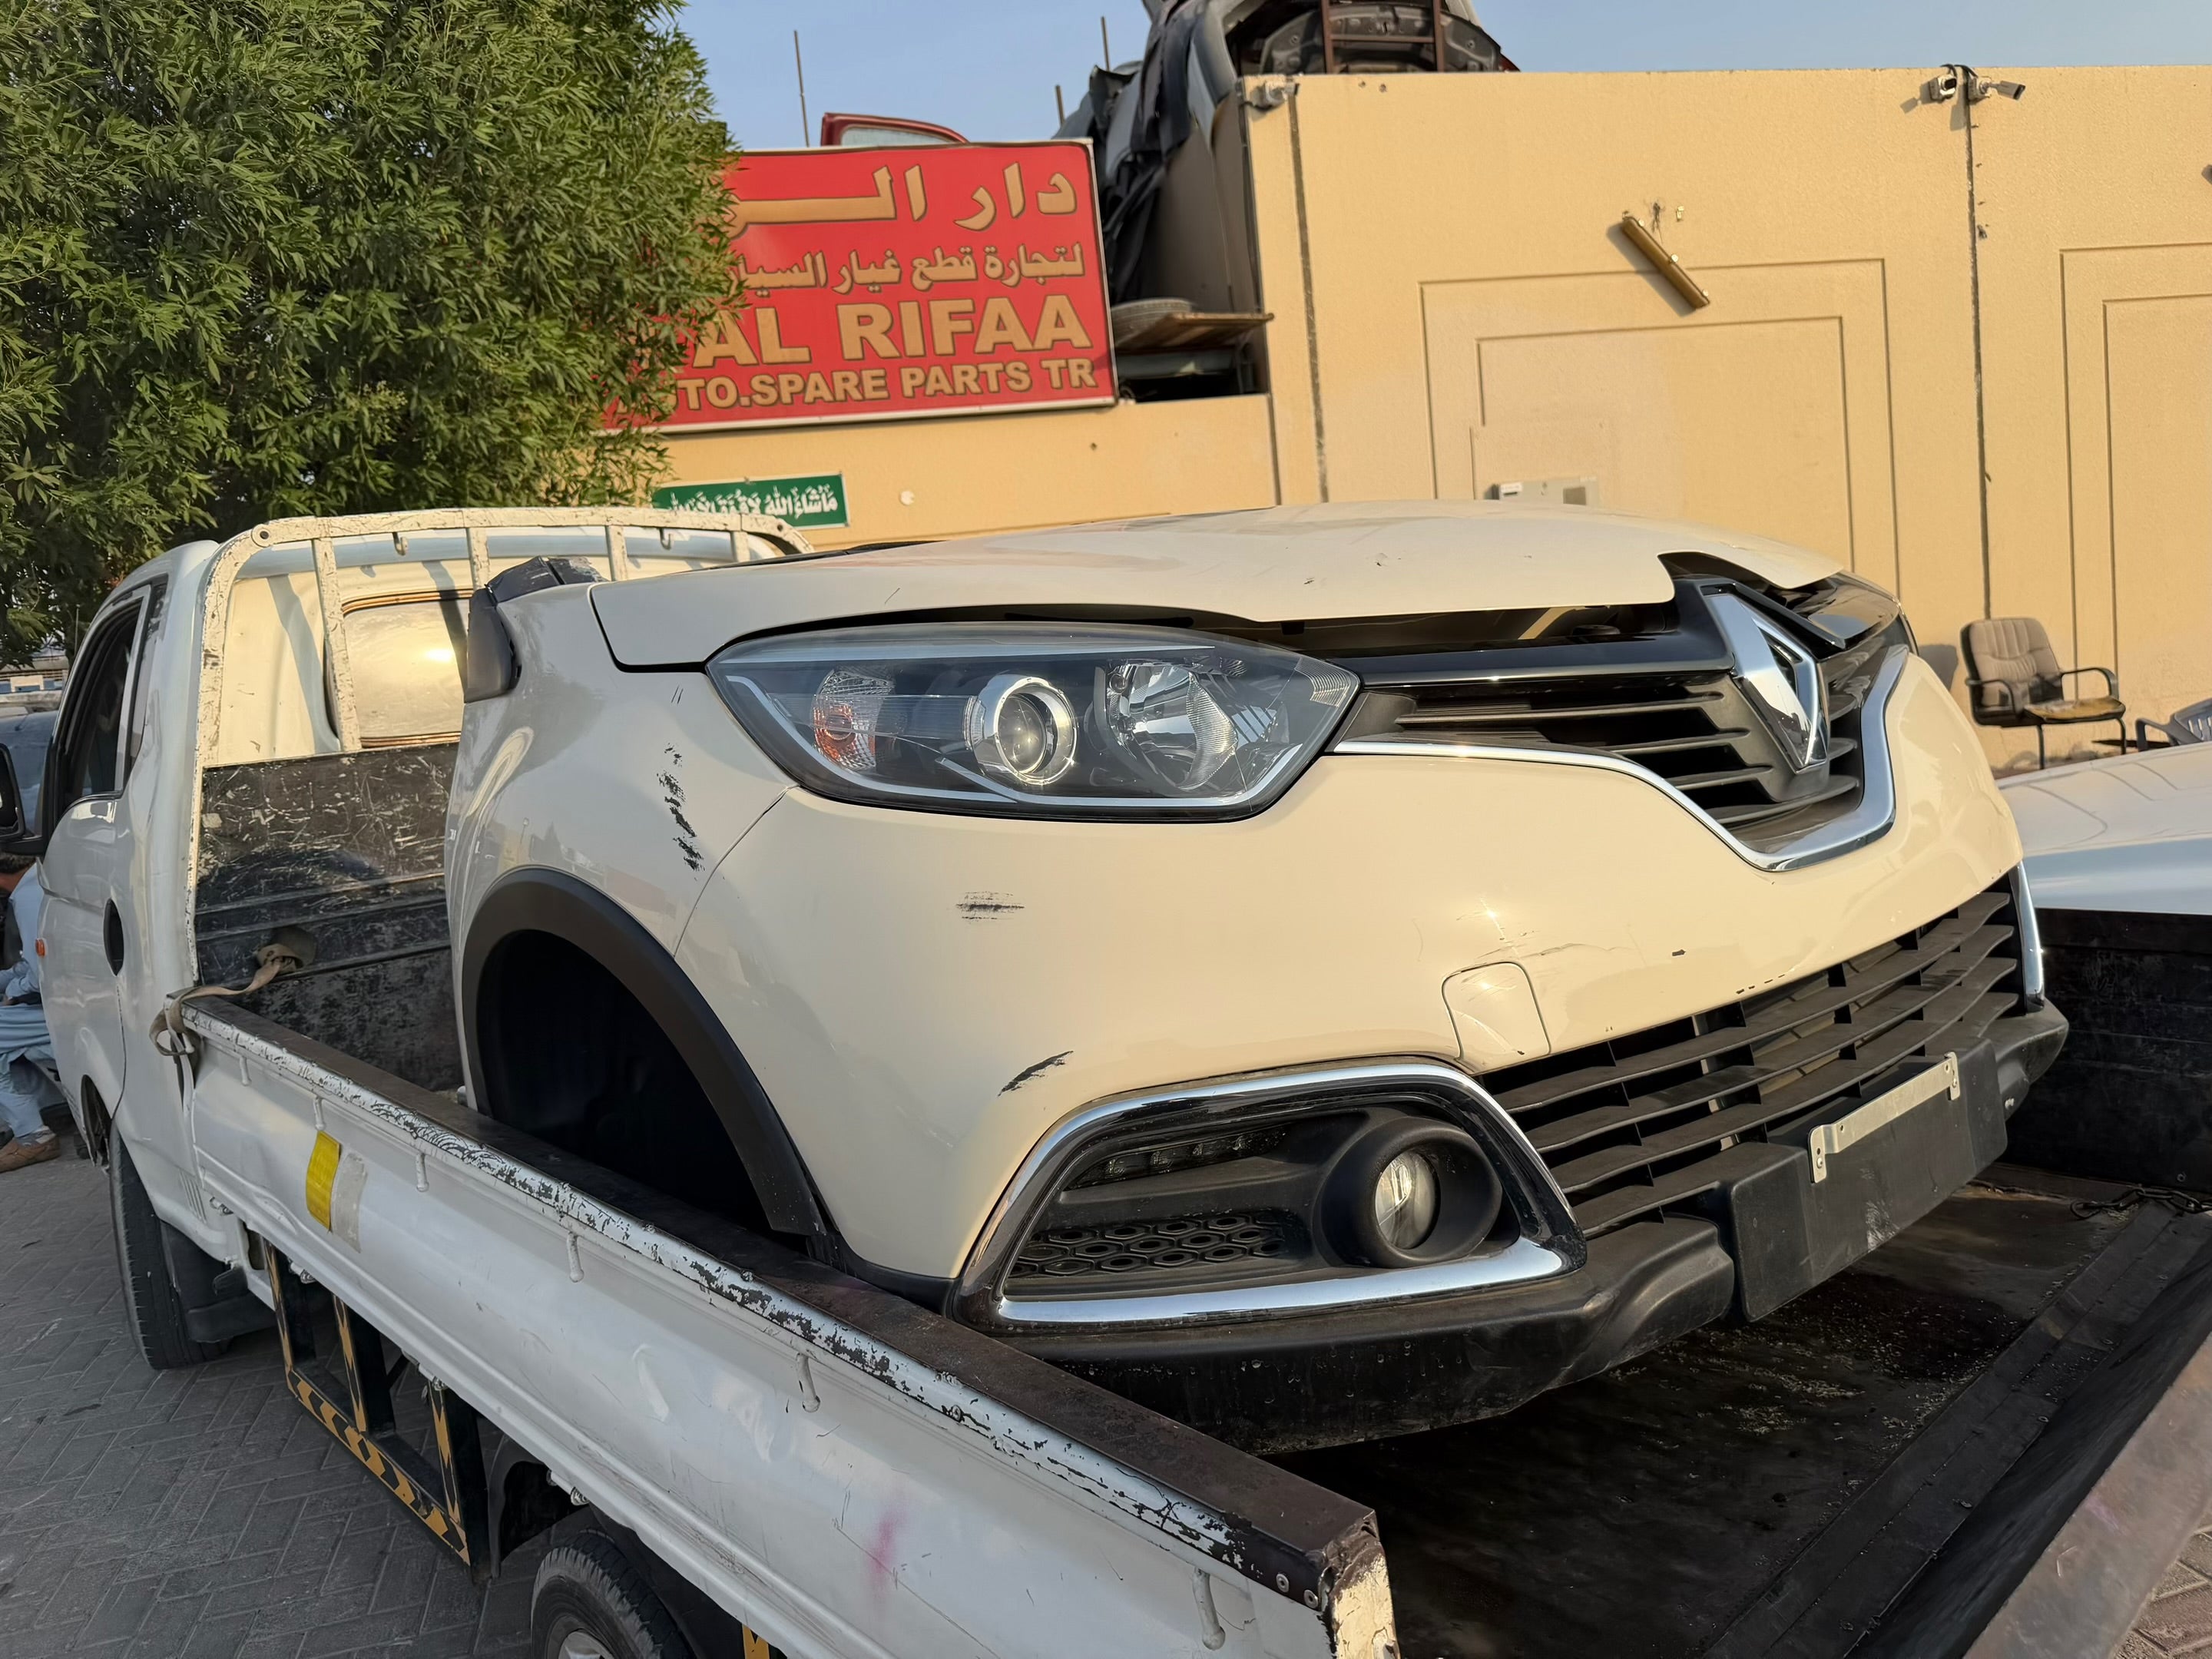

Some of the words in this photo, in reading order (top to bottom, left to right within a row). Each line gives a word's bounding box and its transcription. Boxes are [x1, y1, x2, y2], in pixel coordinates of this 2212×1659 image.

[954, 161, 1078, 232] دار
[728, 250, 829, 299] السيار
[832, 249, 902, 296] غيار
[911, 245, 979, 292] قطع
[983, 242, 1086, 288] لتجارة
[693, 306, 812, 369] AL
[836, 293, 1094, 362] RIFAA
[617, 368, 891, 415] TO.SPARE
[900, 360, 1032, 399] PARTS
[1041, 356, 1098, 389] TR
